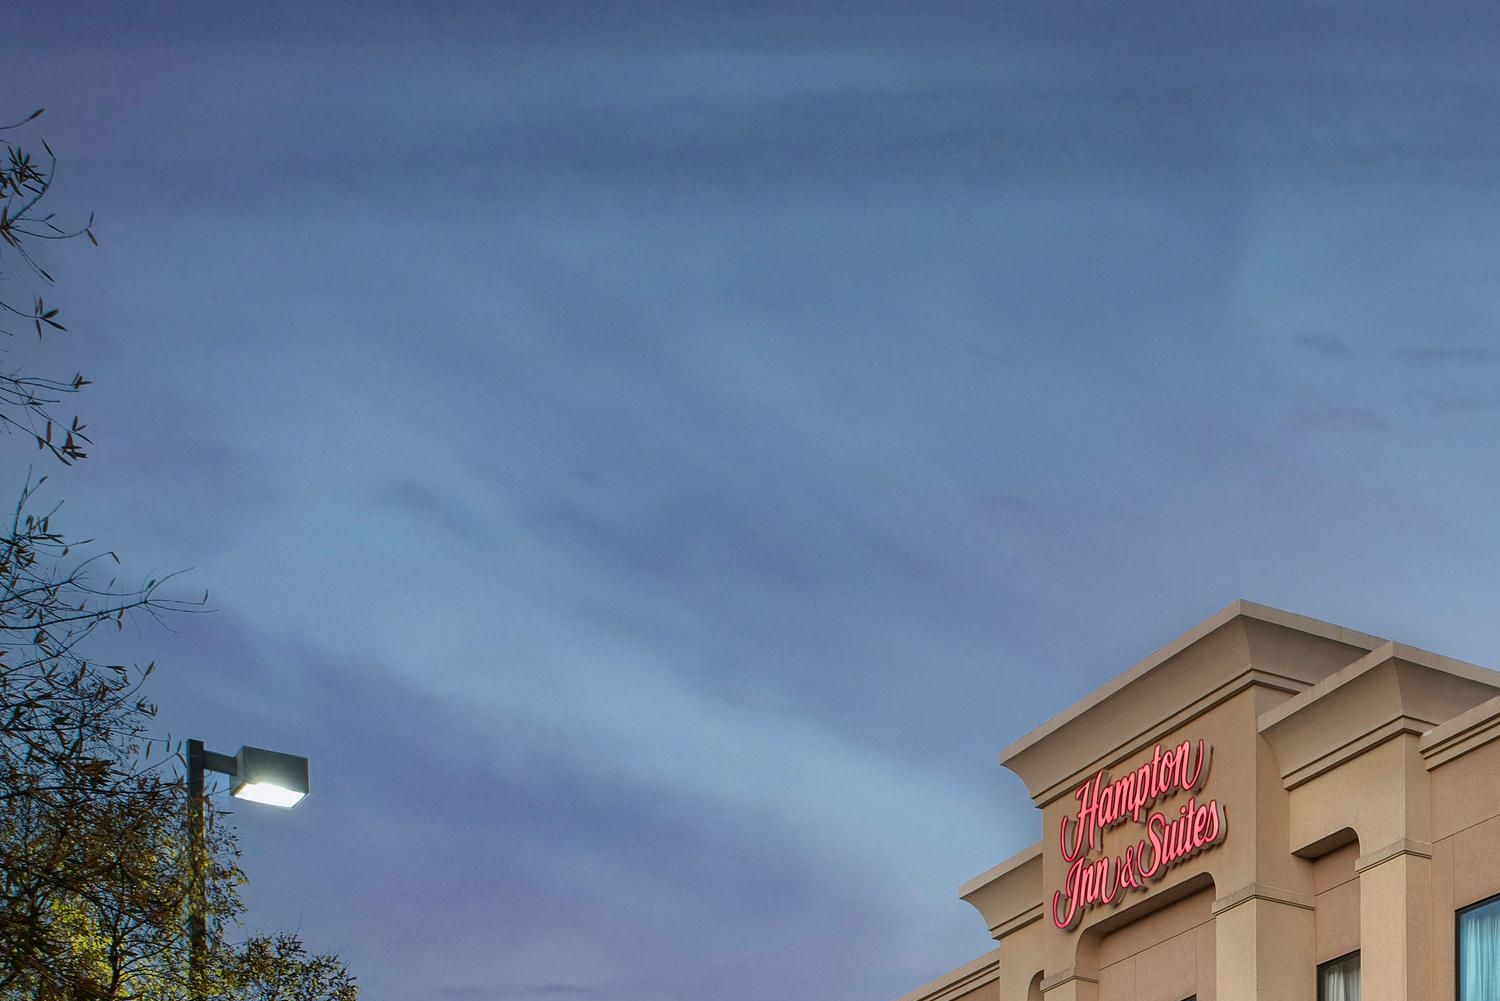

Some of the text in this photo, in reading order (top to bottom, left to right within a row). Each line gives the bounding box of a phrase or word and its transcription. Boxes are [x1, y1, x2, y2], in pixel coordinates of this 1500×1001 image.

[1053, 797, 1220, 929] Inn & Suites
[1060, 739, 1205, 862] Hampton
